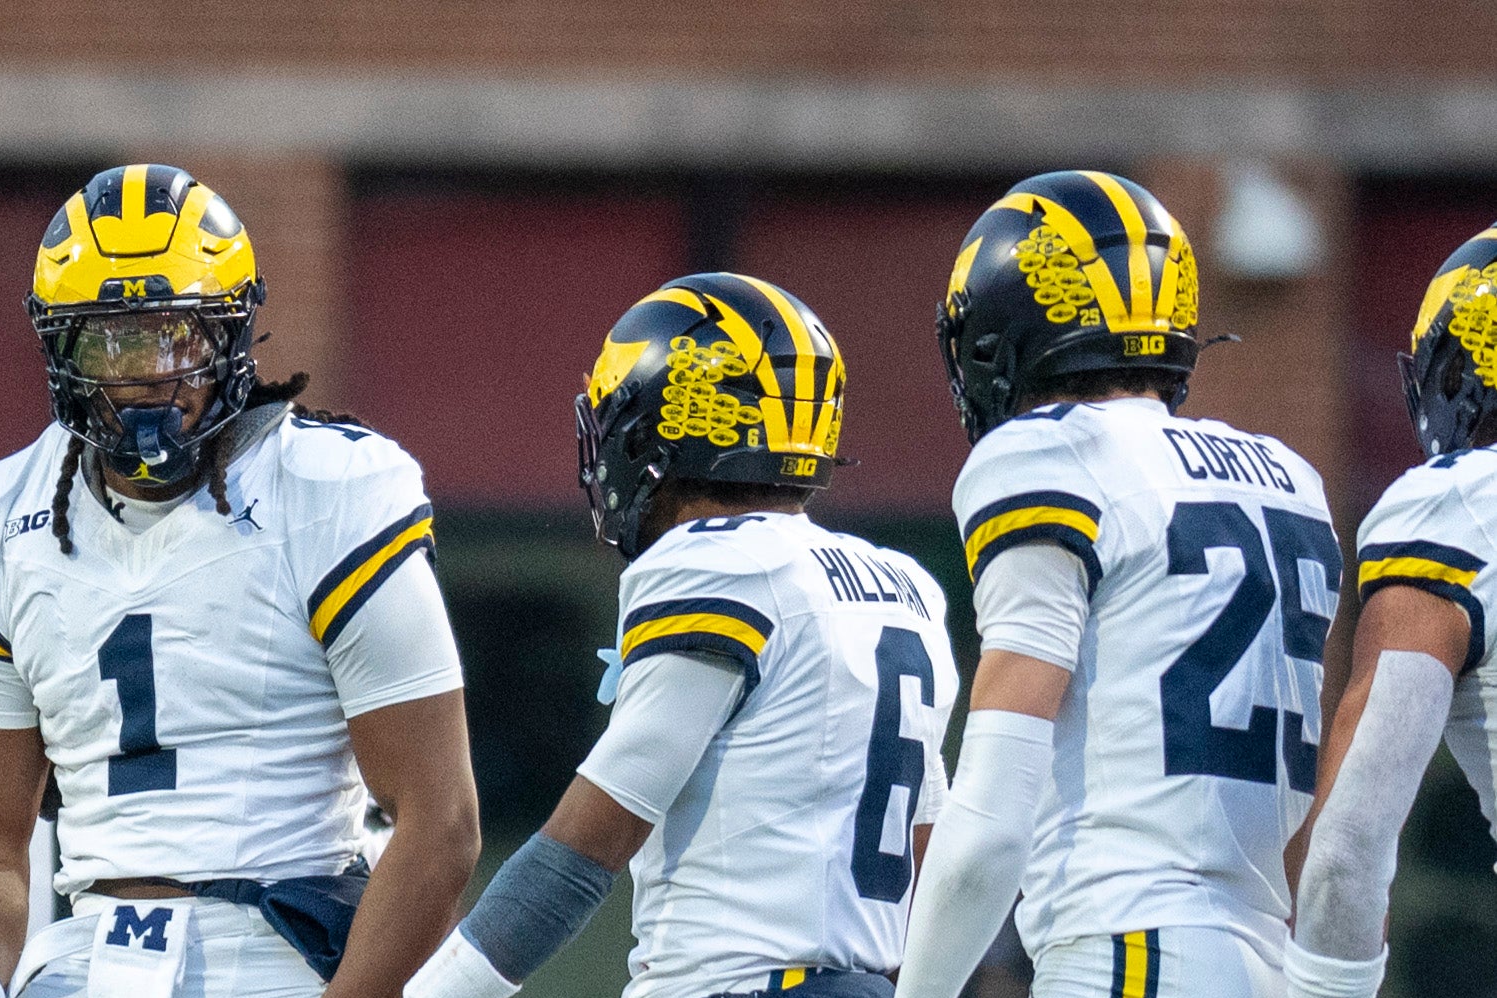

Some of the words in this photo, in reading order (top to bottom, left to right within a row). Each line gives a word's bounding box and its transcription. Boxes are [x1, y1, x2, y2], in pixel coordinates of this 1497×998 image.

[1079, 307, 1101, 327] 25
[747, 428, 760, 448] 6
[1162, 428, 1296, 494] CURTIS
[1159, 501, 1344, 797] 25
[97, 613, 178, 797] 1
[850, 625, 935, 904] 6
[105, 905, 173, 952] M
